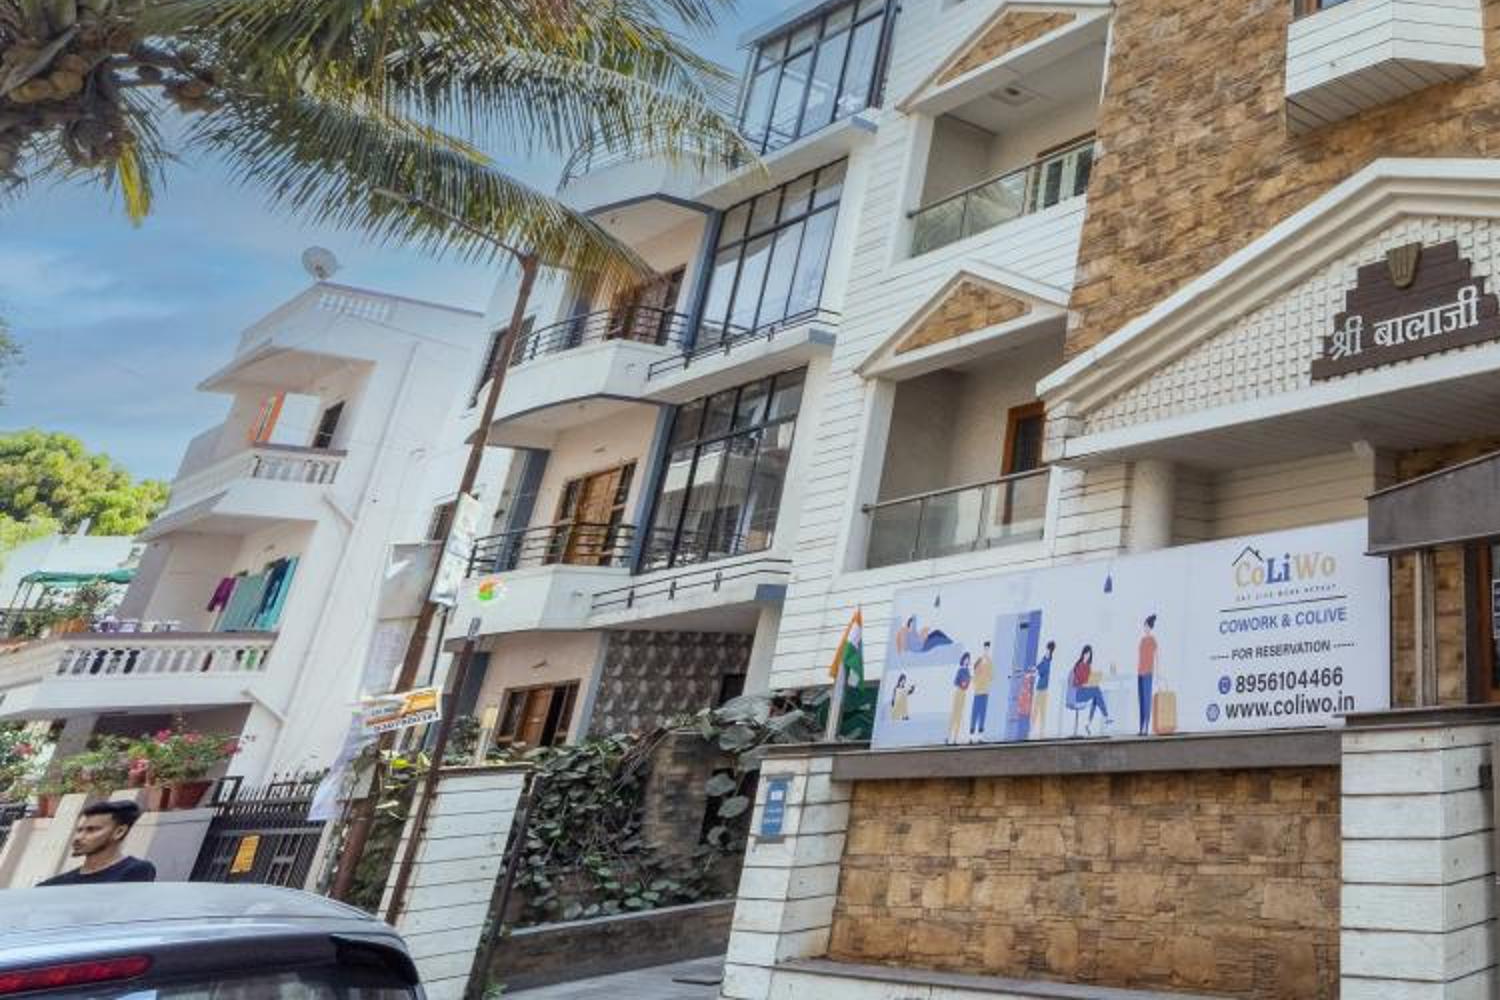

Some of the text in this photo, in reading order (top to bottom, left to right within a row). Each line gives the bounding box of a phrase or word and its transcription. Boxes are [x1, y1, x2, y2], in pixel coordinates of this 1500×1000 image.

[1329, 285, 1482, 361] श्री बालाजी
[1236, 552, 1337, 587] CoLiWo
[1219, 606, 1348, 634] COWORK & COLIVE
[1231, 640, 1331, 660] FOR RESERVATION
[1235, 666, 1344, 693] 8956104466
[1225, 690, 1356, 719] www.coliwo.in
